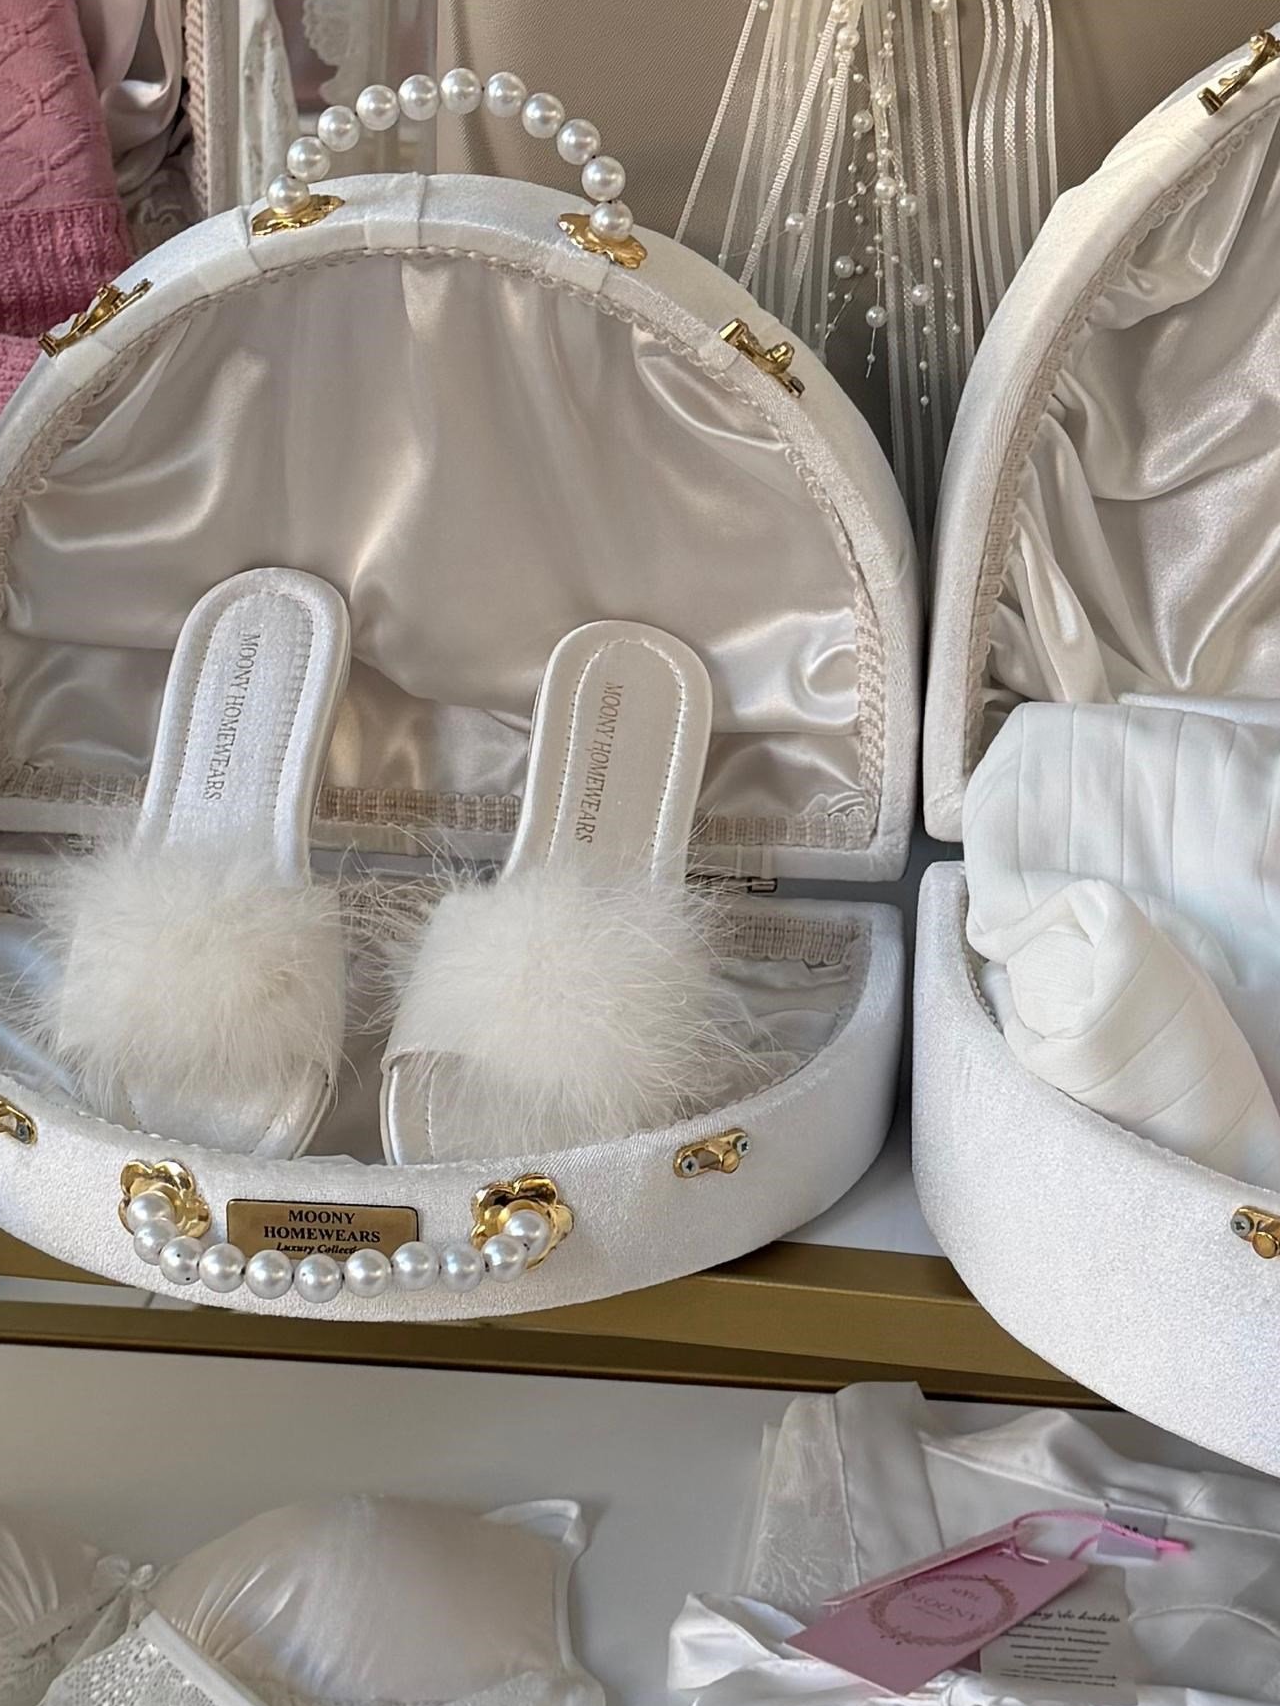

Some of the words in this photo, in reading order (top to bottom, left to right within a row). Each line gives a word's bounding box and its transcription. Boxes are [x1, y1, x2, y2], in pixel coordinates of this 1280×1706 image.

[230, 632, 261, 692] MOONY
[595, 681, 624, 740] MOONY
[202, 694, 246, 801] HOMEWEARS
[575, 740, 612, 844] HOMEWEARS
[263, 1226, 381, 1243] HOMEWEARS
[288, 1209, 356, 1225] MOONY
[276, 1242, 316, 1254] Luxury
